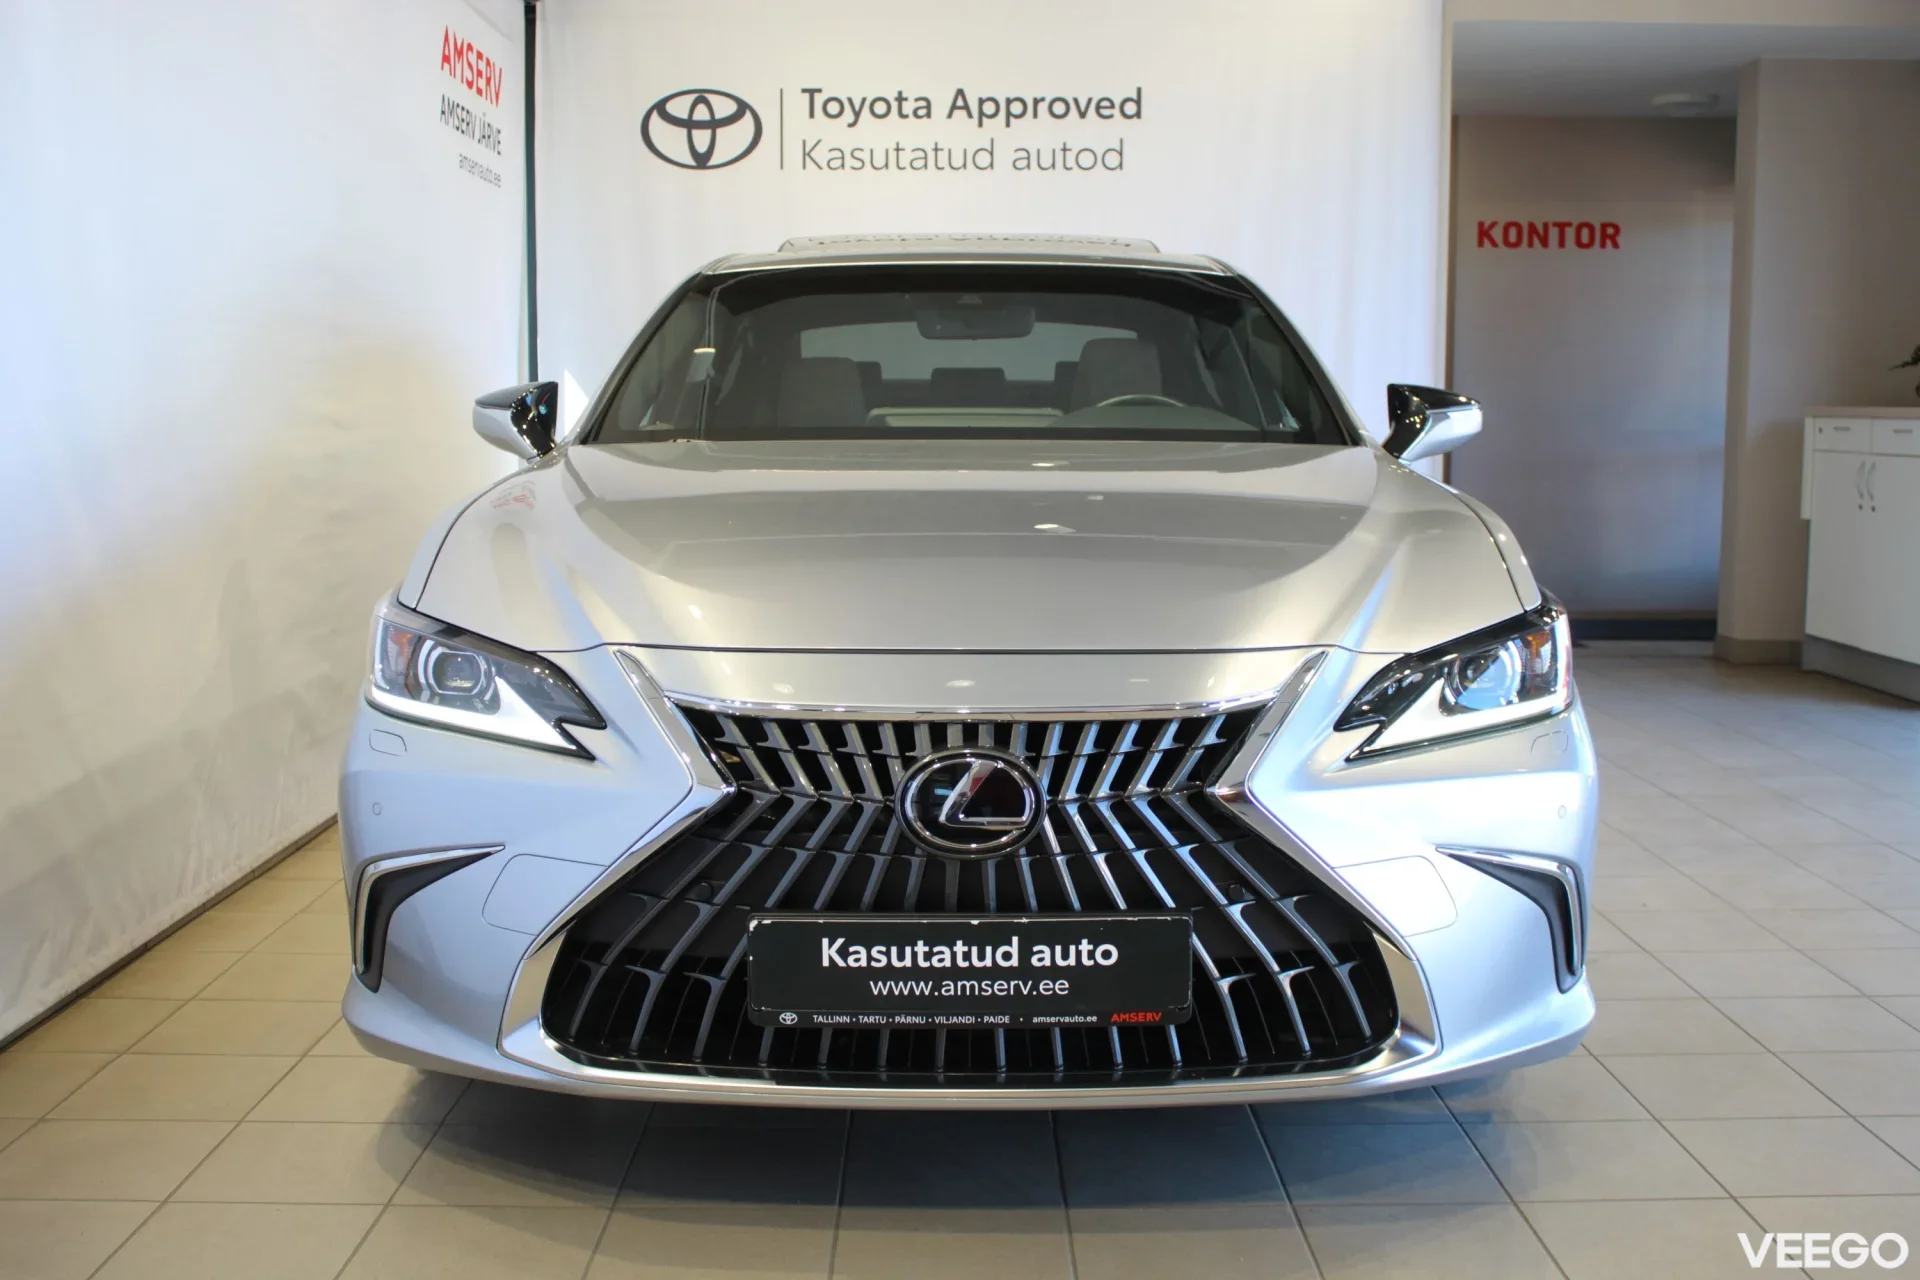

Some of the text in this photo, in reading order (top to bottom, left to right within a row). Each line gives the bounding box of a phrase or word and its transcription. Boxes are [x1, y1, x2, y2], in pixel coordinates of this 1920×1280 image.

[441, 25, 502, 108] AMSERV
[801, 87, 1143, 128] Toyota Approved
[440, 94, 501, 155] AMSERV JÄRVE
[459, 153, 501, 187] amservauto.ee
[801, 138, 1125, 171] Kasutatud autod
[1477, 221, 1621, 249] KONTOR
[821, 936, 1119, 968] Kasutatud auto
[869, 977, 1069, 996] www.amserv.ee
[812, 1012, 1162, 1024] TALLINN TARTU PÄRNU VILJANDI PAIDE amservauto.ee AMSERV
